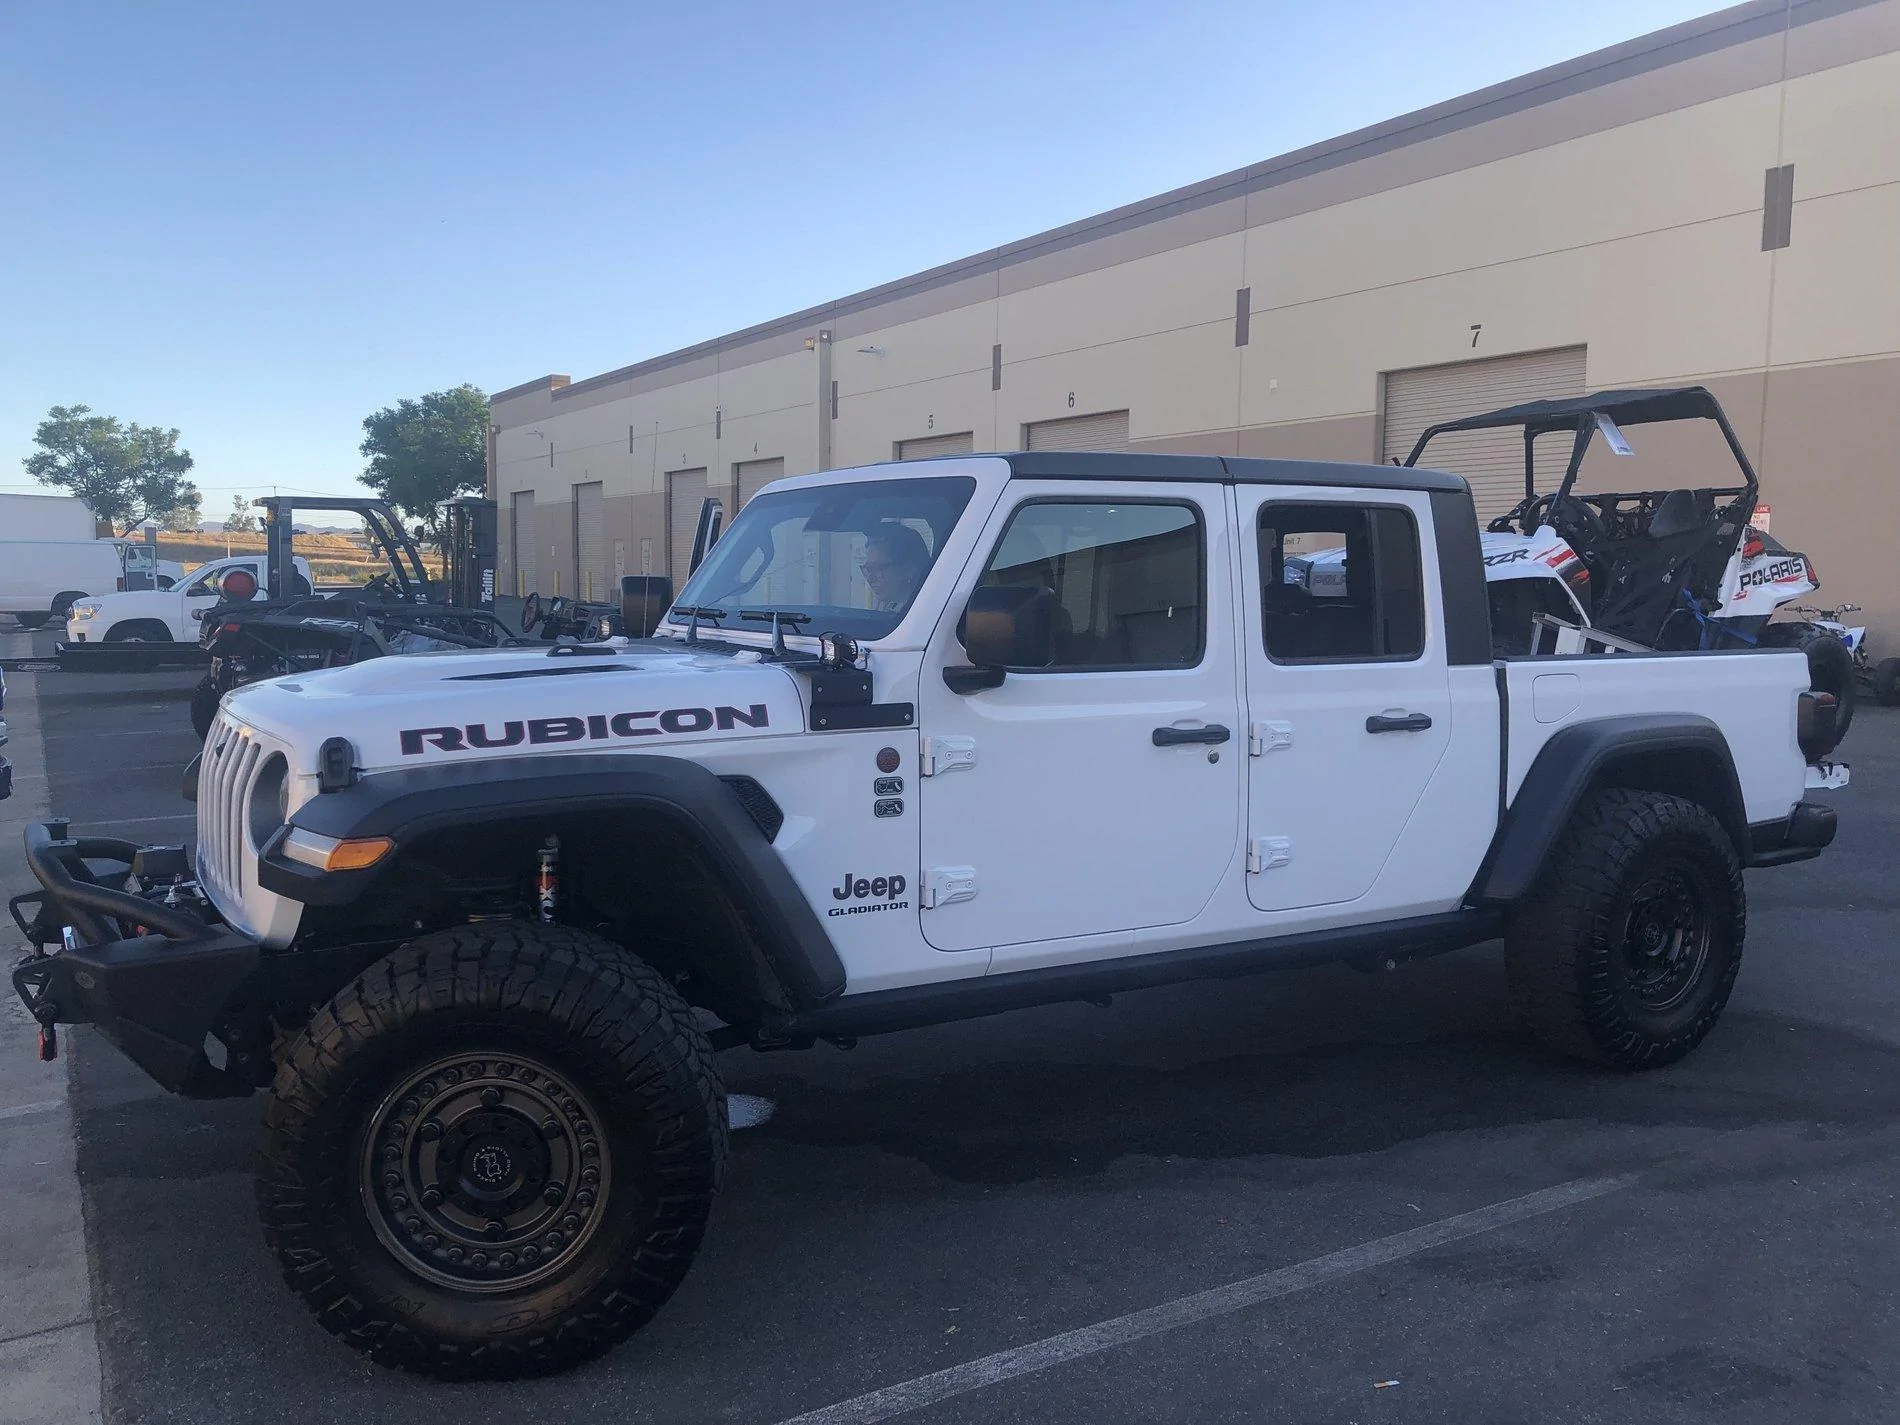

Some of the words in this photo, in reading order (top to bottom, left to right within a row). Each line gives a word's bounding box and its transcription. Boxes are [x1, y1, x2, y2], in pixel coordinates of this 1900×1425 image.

[1470, 324, 1481, 347] 7
[1067, 391, 1075, 408] 6
[928, 414, 934, 429] 5
[1739, 557, 1803, 591] POLARIS
[399, 704, 770, 756] RUBICON
[832, 872, 906, 900] Jeep
[828, 901, 909, 917] GLADIATOR
